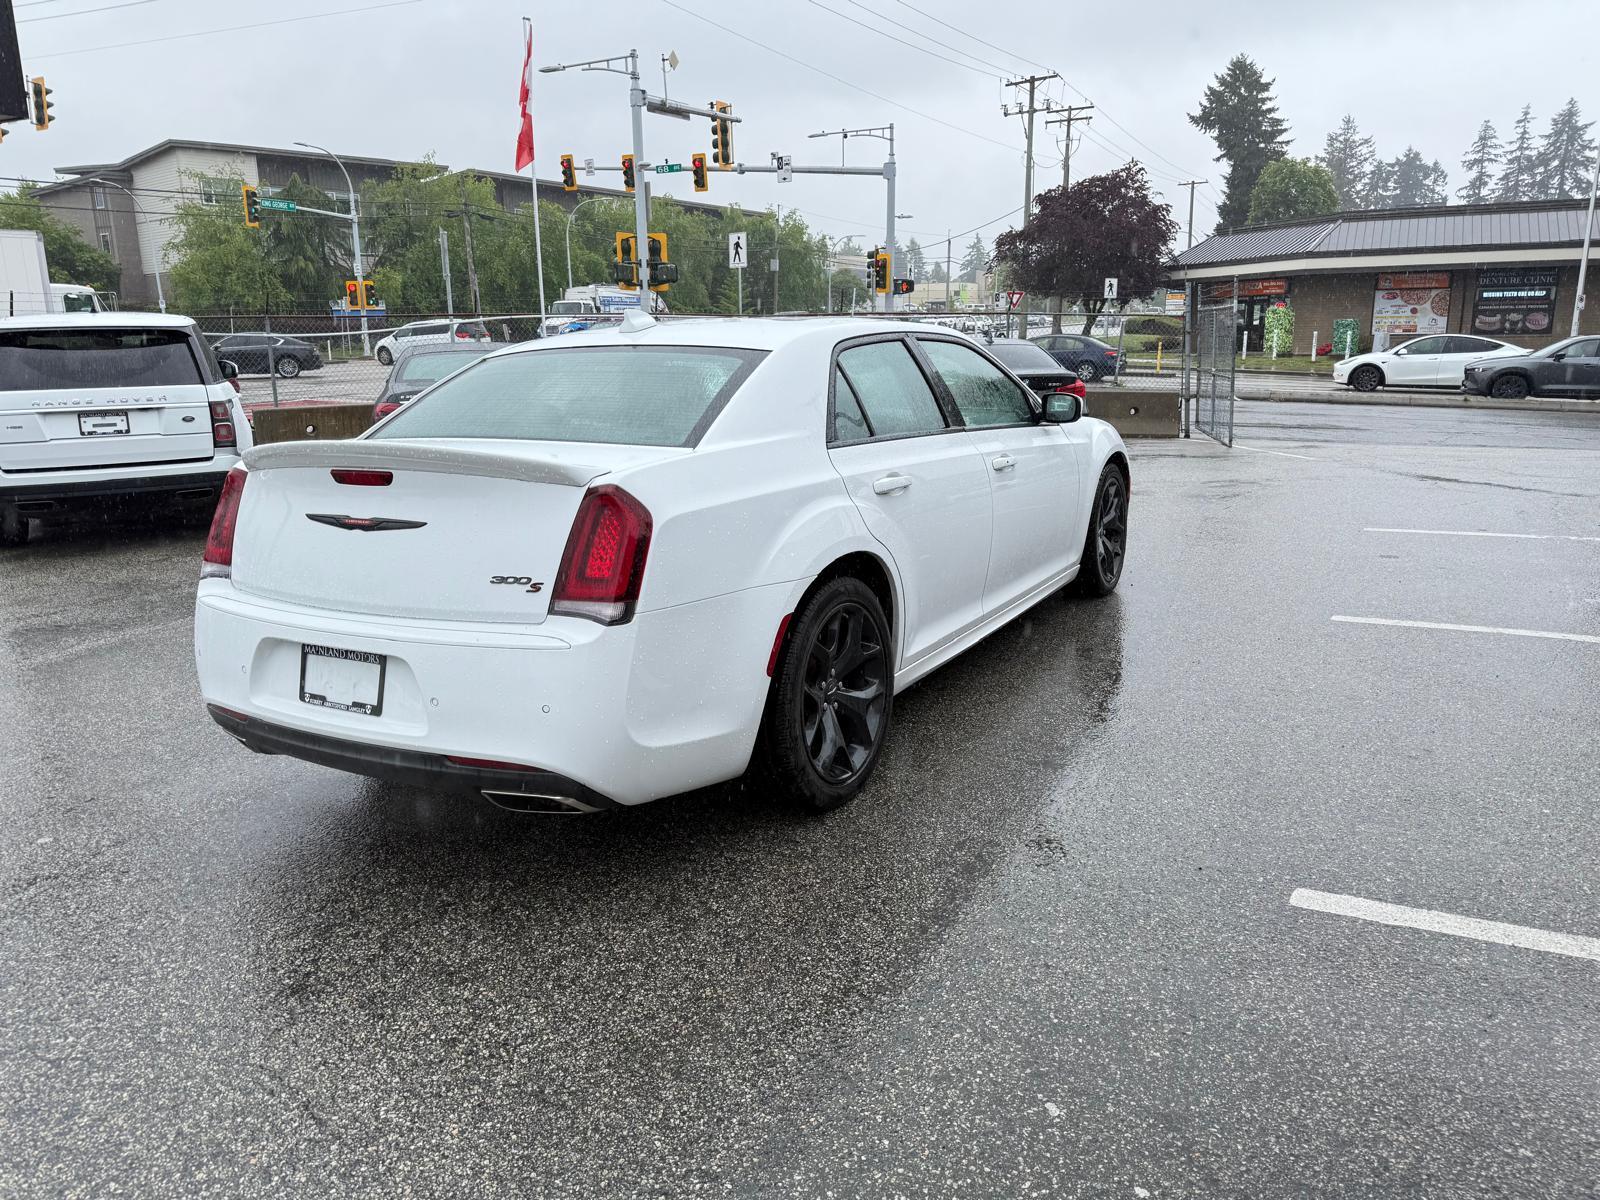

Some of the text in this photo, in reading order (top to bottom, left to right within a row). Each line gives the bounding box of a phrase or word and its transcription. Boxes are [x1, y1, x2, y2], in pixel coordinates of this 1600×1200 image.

[261, 200, 271, 208] KING
[272, 200, 288, 208] GEORGE
[1480, 276, 1556, 285] DENTURE CLINIC
[106, 394, 167, 404] ROVER
[348, 706, 366, 714] LANGLEY
